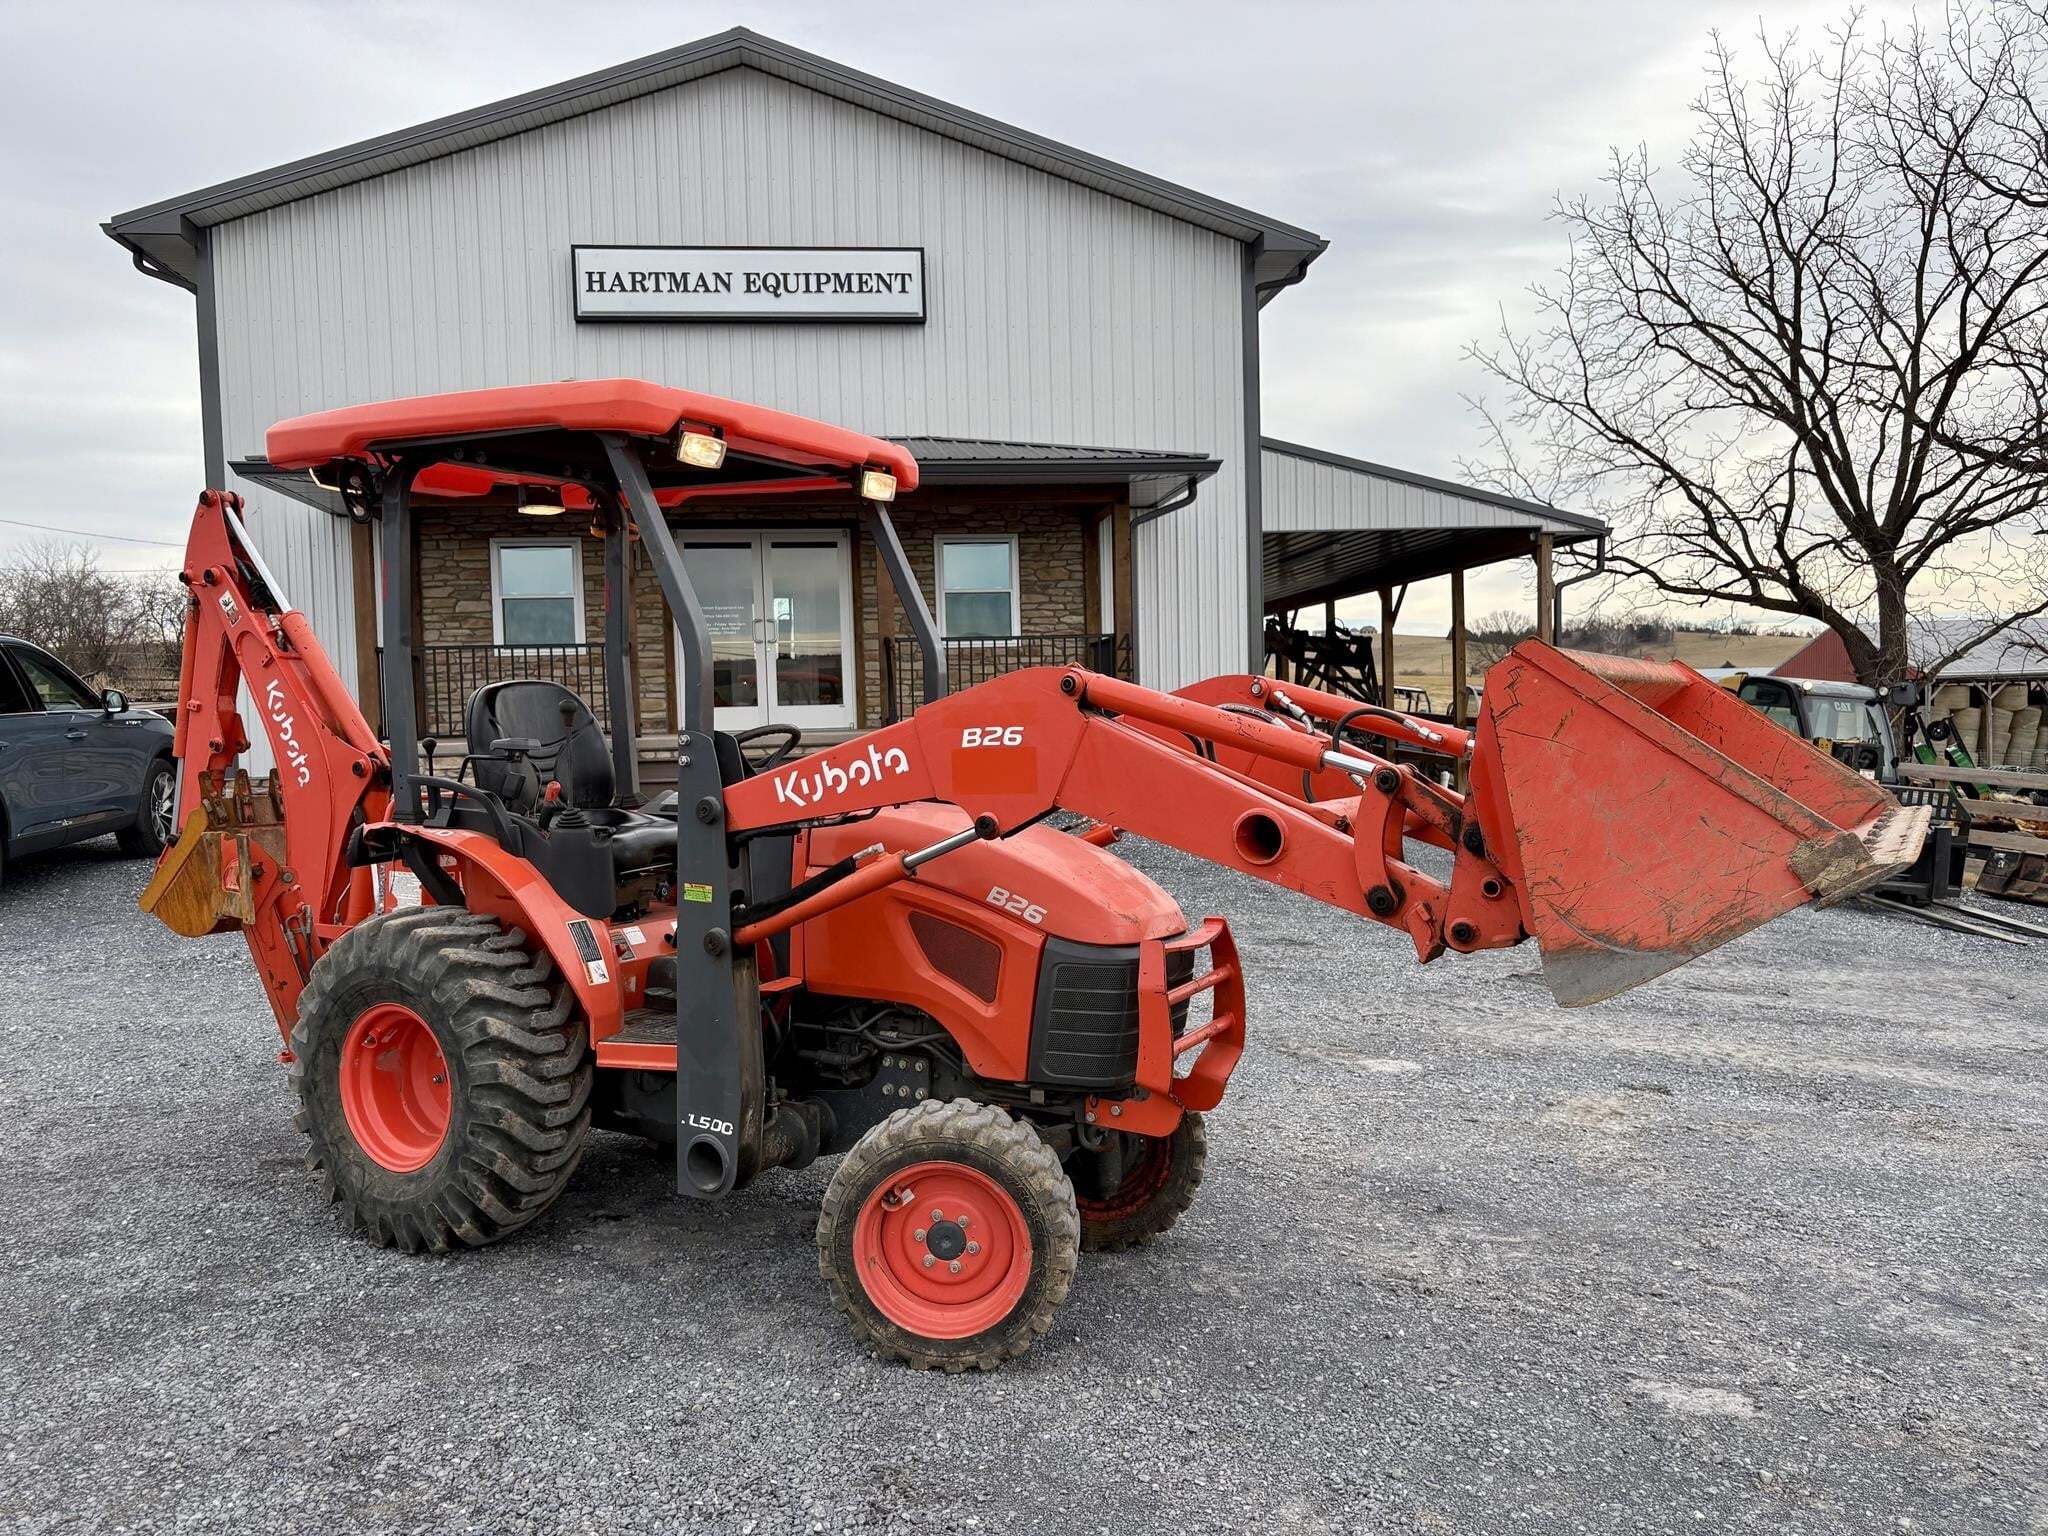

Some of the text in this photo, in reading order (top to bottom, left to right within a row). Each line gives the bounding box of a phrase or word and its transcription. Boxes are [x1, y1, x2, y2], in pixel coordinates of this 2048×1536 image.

[585, 271, 913, 298] HARTMAN EQUIPMENT
[1833, 701, 1852, 712] CAT
[266, 679, 310, 788] Kubota
[961, 726, 1025, 748] B26
[774, 744, 910, 807] Kubota
[985, 886, 1048, 924] B26
